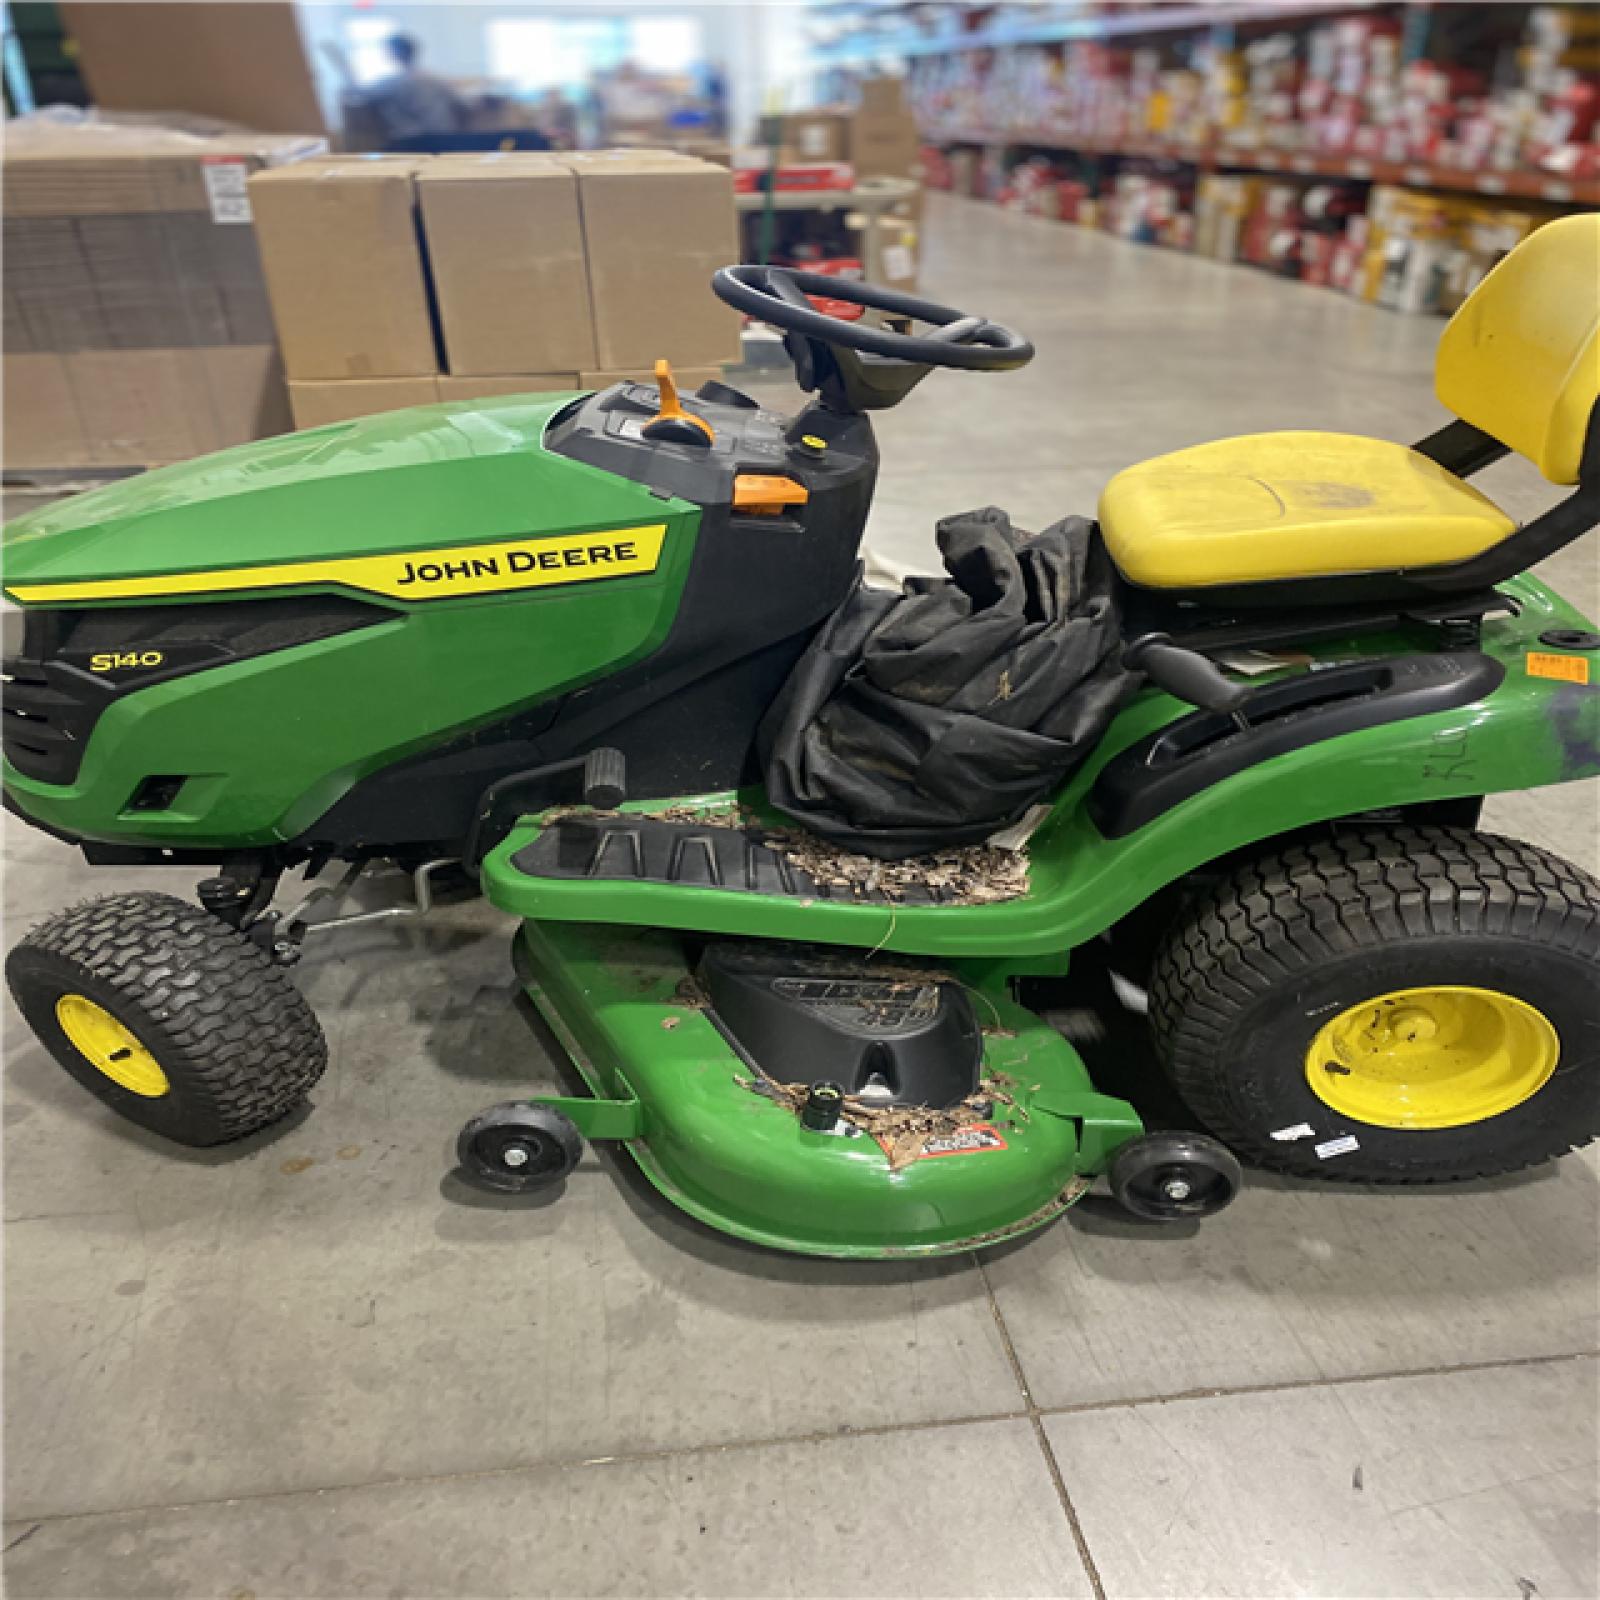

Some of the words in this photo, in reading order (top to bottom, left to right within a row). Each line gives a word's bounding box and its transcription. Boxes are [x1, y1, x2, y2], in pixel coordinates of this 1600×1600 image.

[397, 557, 499, 585] JOHN
[508, 542, 638, 573] DEERE
[90, 650, 162, 671] S140
